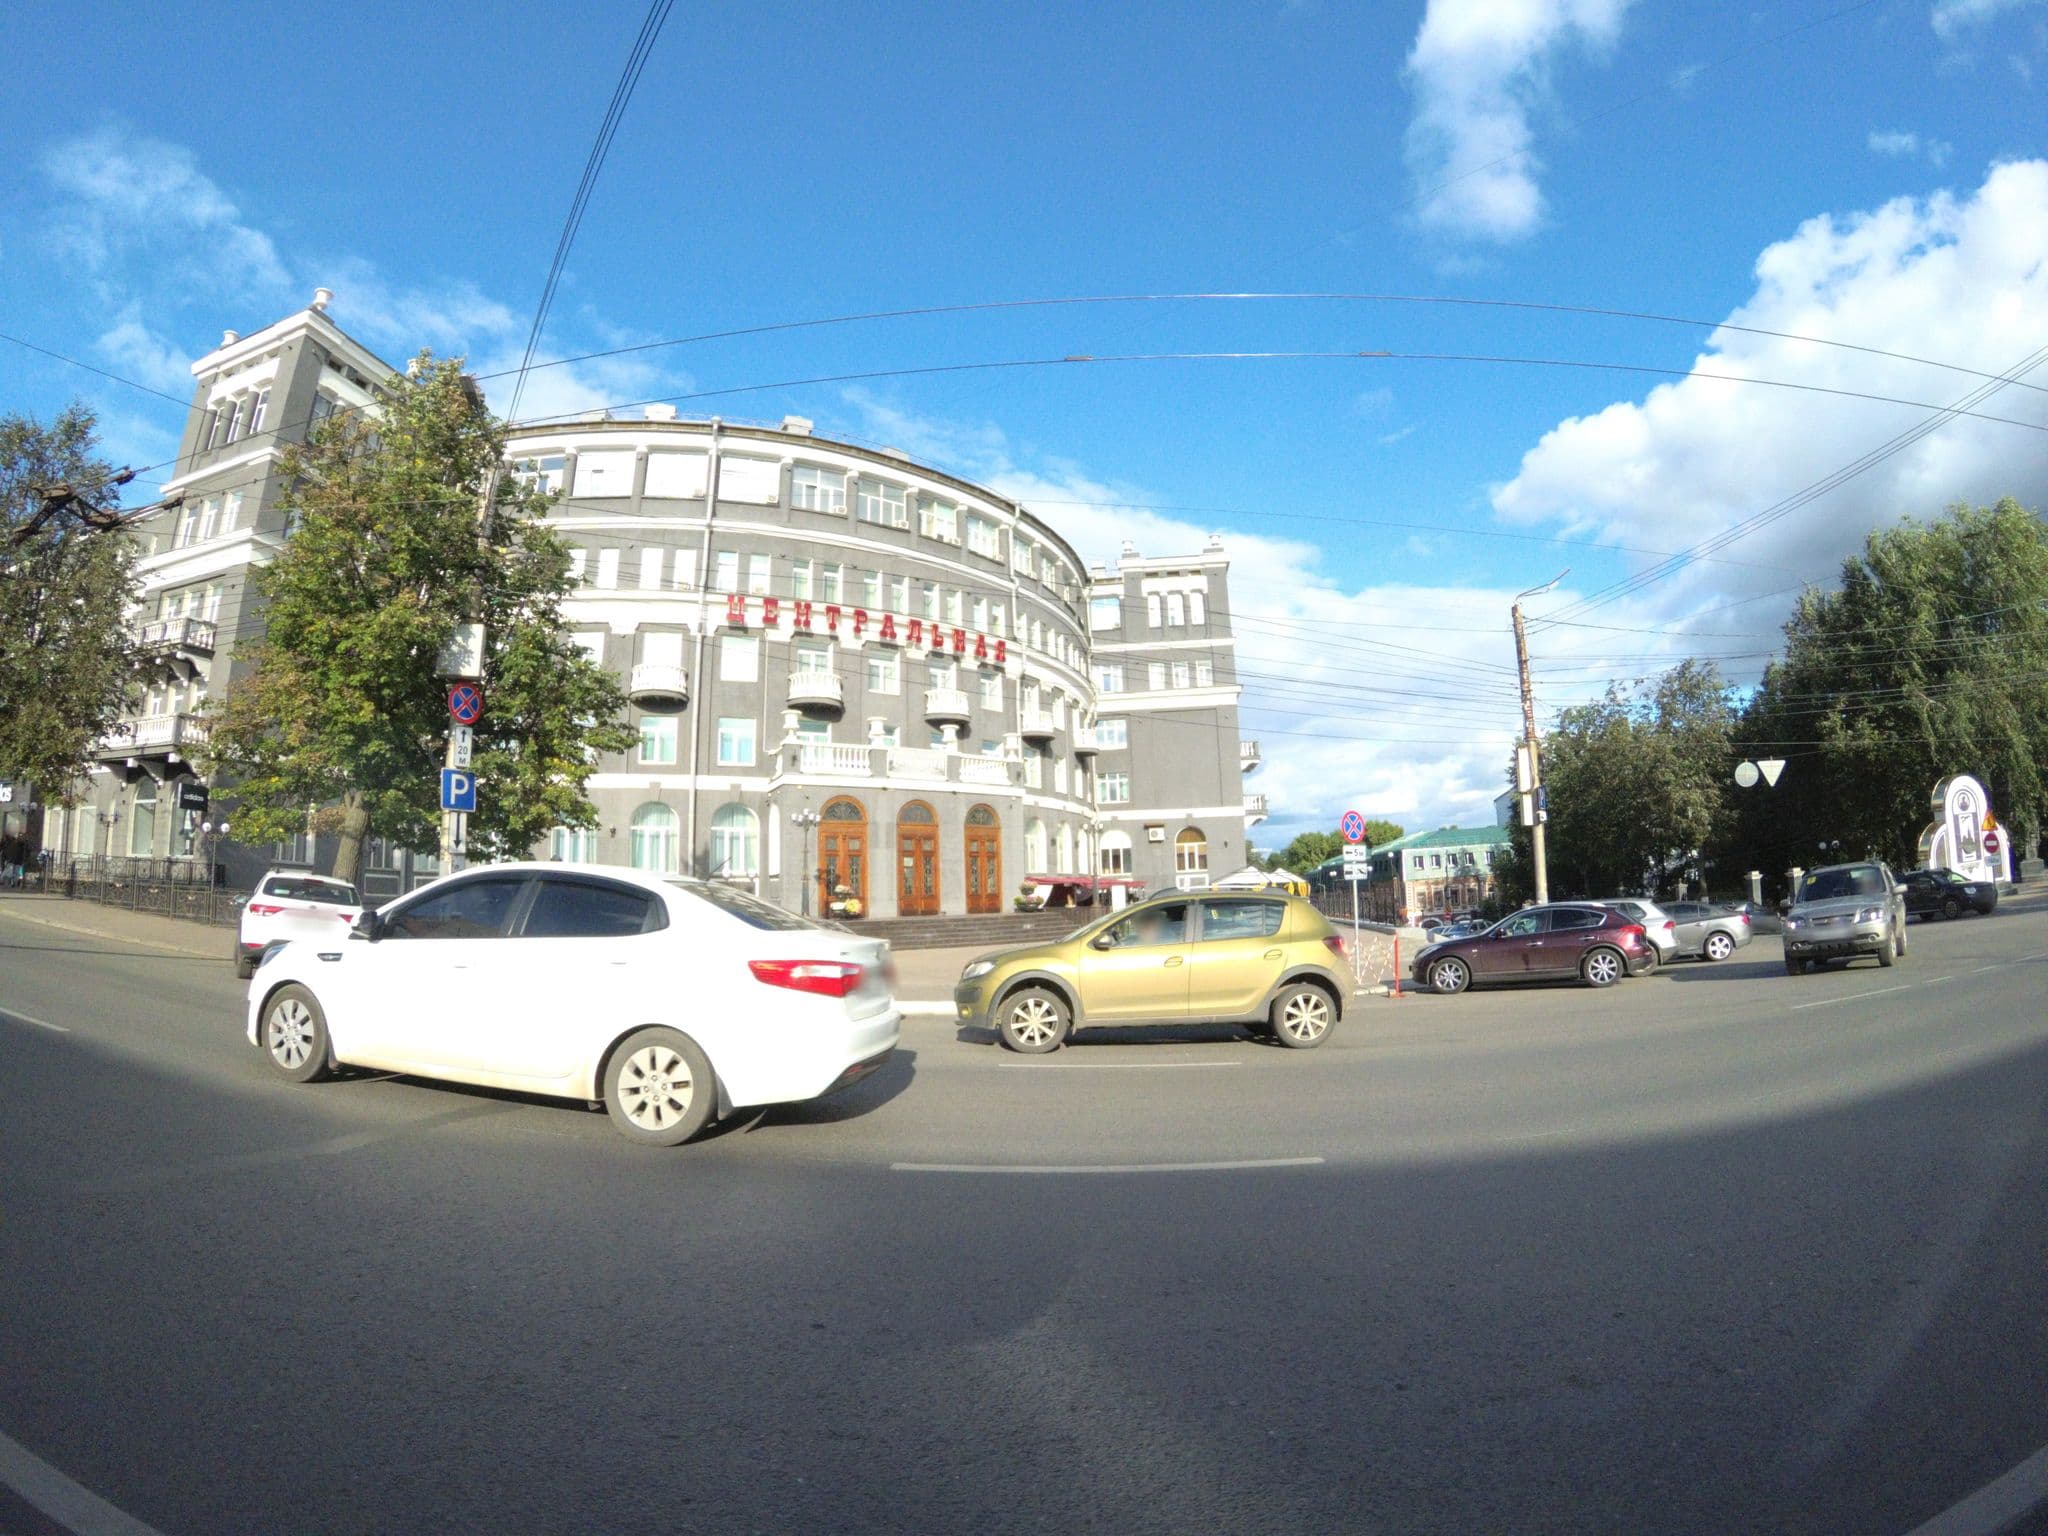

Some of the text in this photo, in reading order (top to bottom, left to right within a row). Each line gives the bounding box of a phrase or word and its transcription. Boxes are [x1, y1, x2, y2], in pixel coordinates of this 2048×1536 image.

[727, 594, 1007, 663] ЦЕНТРАЛЬНАЯ
[457, 745, 468, 755] 20
[450, 774, 469, 805] P
